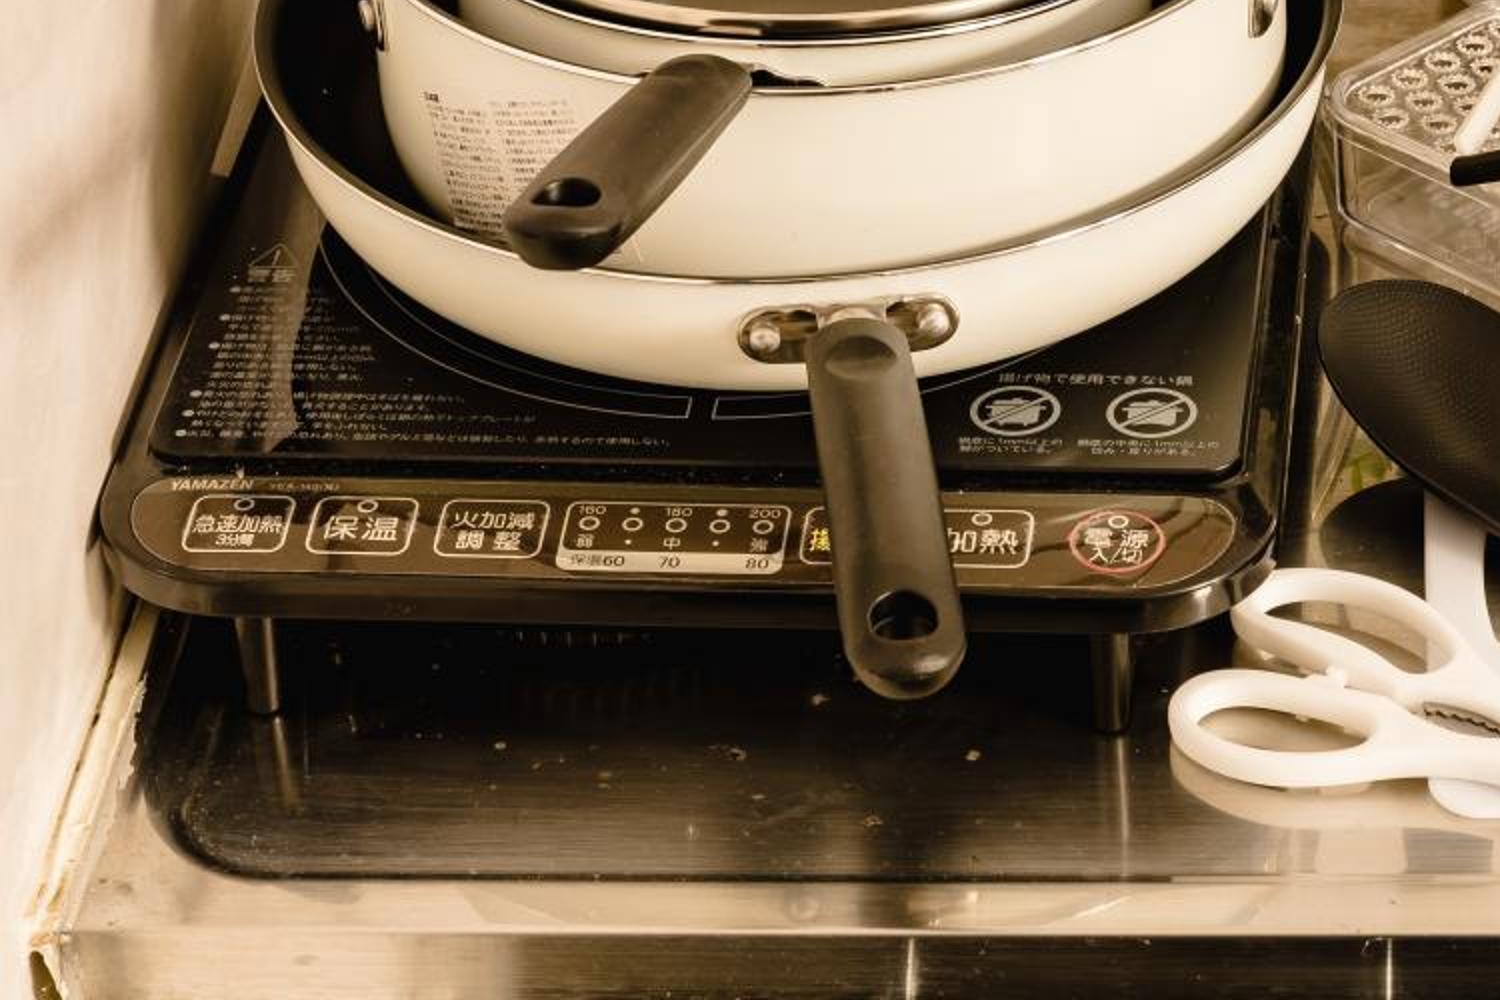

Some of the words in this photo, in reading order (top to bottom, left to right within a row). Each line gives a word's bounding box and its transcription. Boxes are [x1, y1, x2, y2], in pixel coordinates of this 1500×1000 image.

[172, 479, 254, 491] YAMAZEN
[451, 511, 536, 530] 火加減
[578, 505, 607, 516] 160
[665, 507, 693, 518] 180
[750, 508, 782, 519] 200
[323, 515, 399, 541] 保温
[455, 530, 523, 551] 調整
[663, 536, 681, 551] 中
[1083, 528, 1149, 550] 電源
[659, 556, 681, 569] 70
[745, 559, 770, 570] 80
